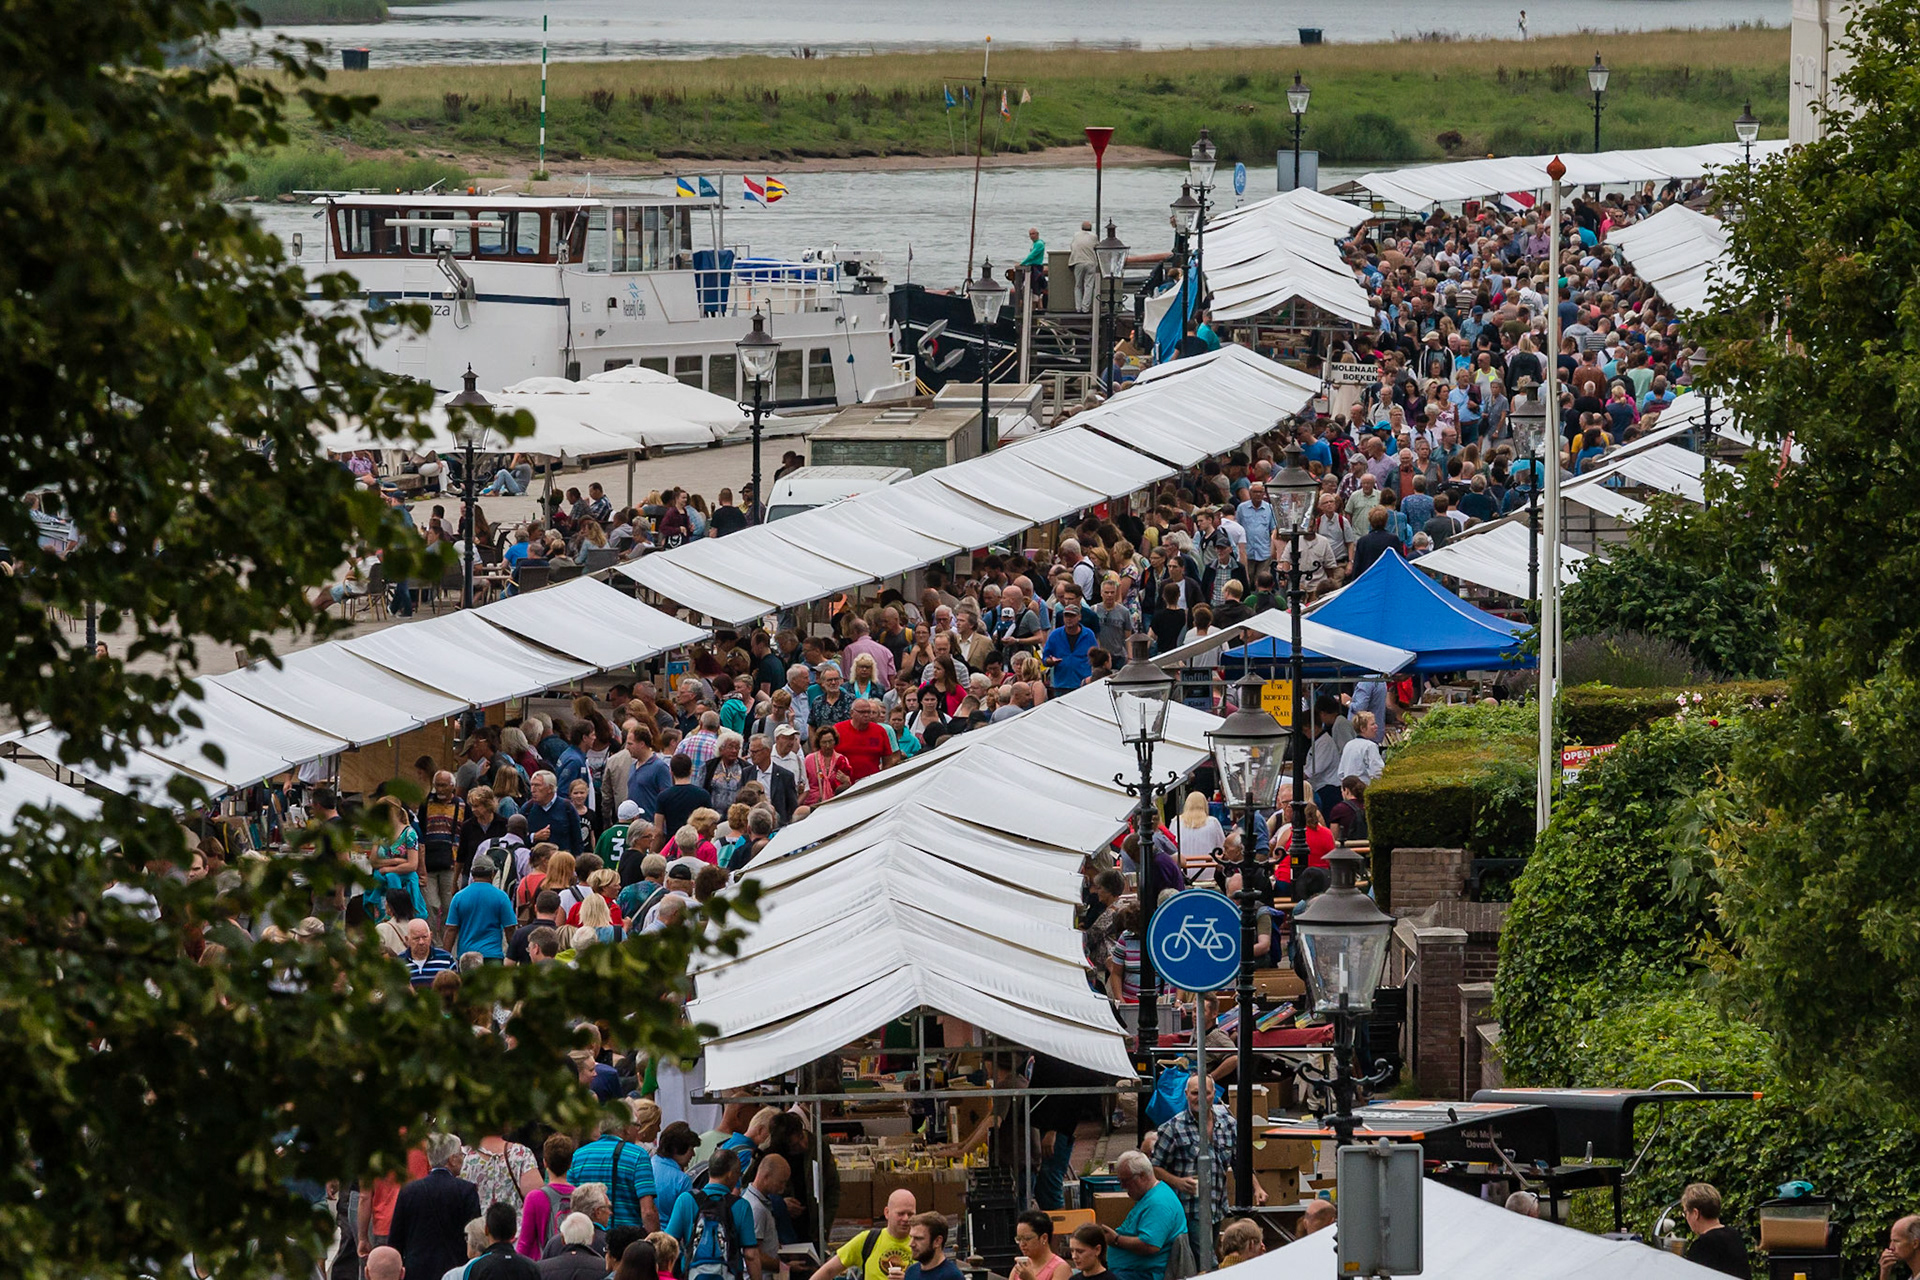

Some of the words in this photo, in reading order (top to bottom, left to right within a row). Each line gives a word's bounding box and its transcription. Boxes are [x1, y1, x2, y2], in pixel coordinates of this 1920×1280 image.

[1331, 364, 1378, 374] MOLENAAR
[1342, 373, 1378, 382] BOEKEN
[1563, 750, 1591, 761] OPEN
[610, 837, 625, 861] 3
